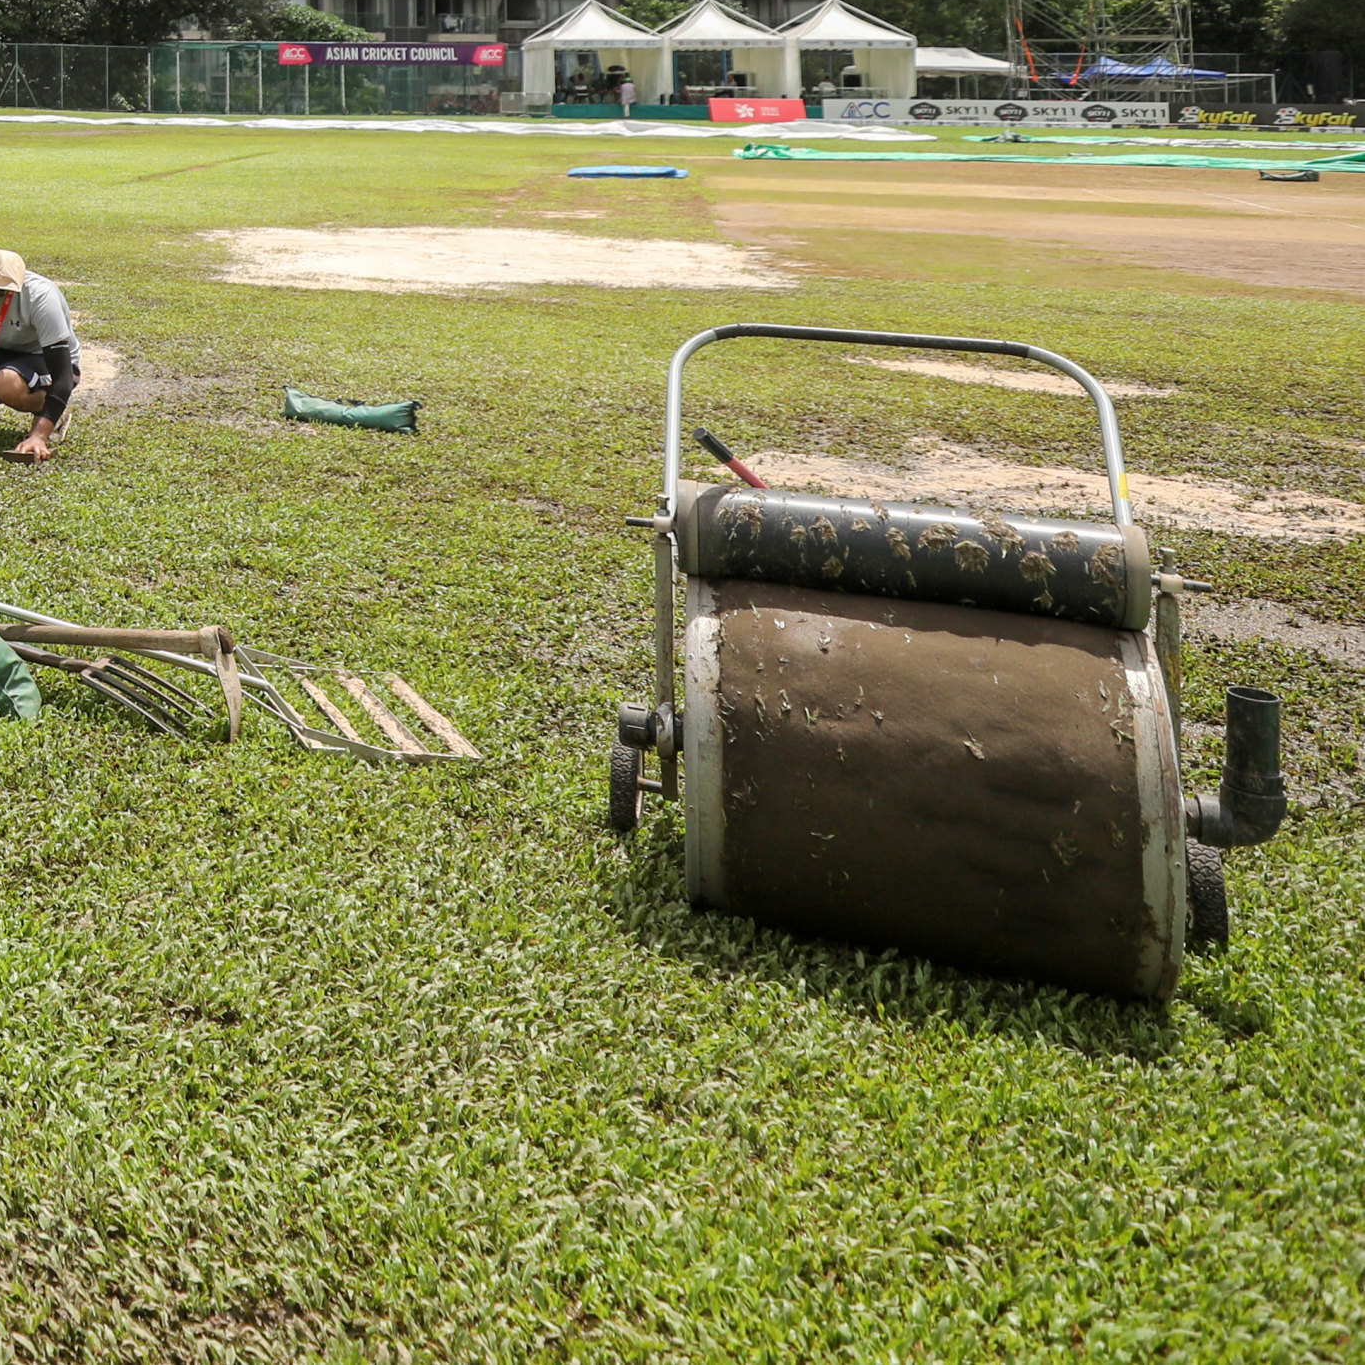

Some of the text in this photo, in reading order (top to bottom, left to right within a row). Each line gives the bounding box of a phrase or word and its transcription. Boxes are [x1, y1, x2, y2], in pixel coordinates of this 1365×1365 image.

[326, 46, 458, 62] ASIAN CRICKET COUNCIL
[945, 105, 988, 115] SKY11
[1032, 107, 1076, 116] SKY11
[1120, 108, 1166, 117] SKY11
